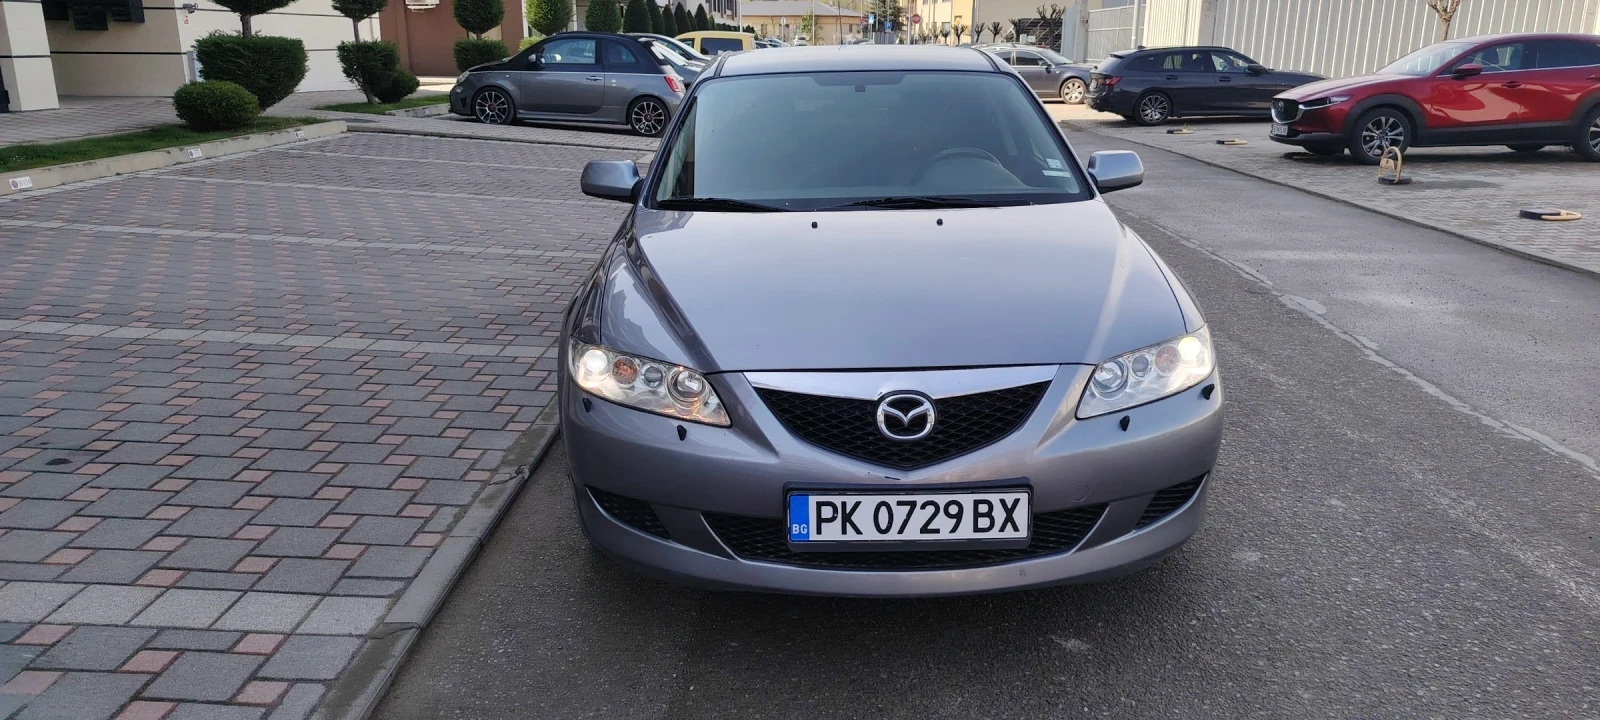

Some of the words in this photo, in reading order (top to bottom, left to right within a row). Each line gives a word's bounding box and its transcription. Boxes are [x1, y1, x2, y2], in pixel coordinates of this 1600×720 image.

[815, 500, 863, 535] PK
[873, 499, 964, 535] 0729
[972, 498, 1021, 533] BX
[792, 523, 808, 535] BG
